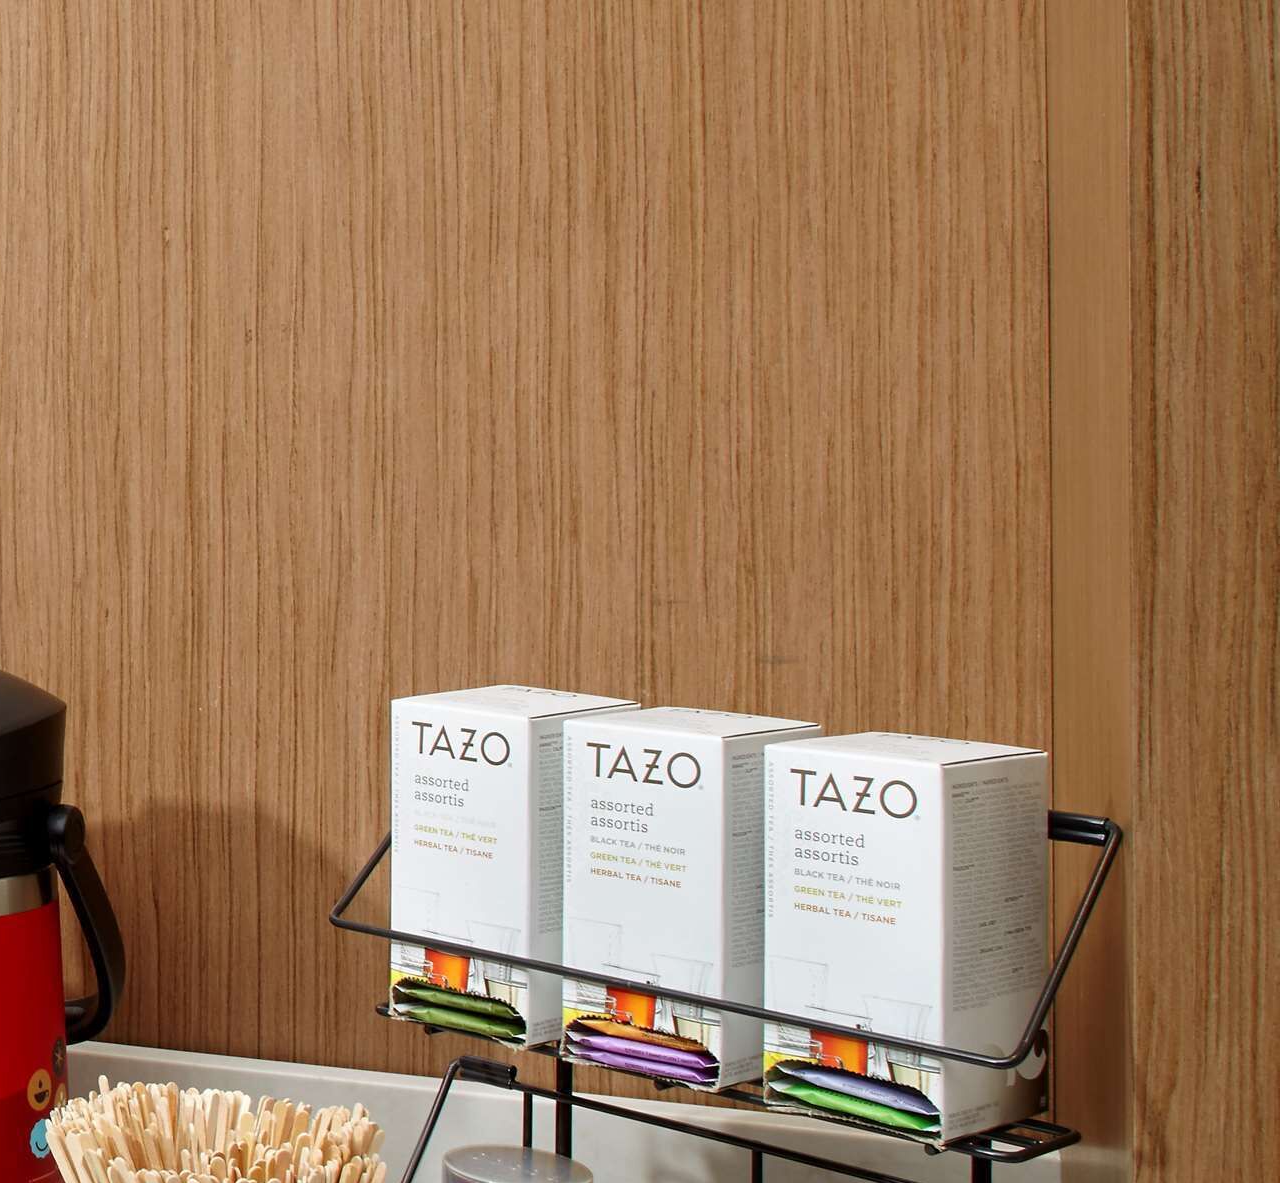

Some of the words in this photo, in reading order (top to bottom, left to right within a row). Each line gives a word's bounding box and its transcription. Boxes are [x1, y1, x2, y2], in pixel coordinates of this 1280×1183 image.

[411, 721, 510, 766] TAZO
[587, 742, 701, 788] TAZO
[414, 774, 469, 792] assorted
[790, 768, 917, 819] TAZO
[413, 790, 465, 808] assortis
[591, 798, 654, 817] assorted
[413, 824, 439, 834] GREEN
[440, 828, 454, 837] TEA
[479, 835, 497, 844] VERT
[591, 816, 648, 833] assortis
[590, 835, 617, 846] BLACK
[620, 839, 635, 848] TEA
[663, 846, 686, 856] NOIR
[795, 828, 865, 848] assorted
[414, 839, 442, 850] HERBAL
[443, 844, 458, 853] TEA
[465, 848, 493, 859] TISANE
[794, 847, 859, 866] assortis
[590, 851, 618, 862] GREEN
[621, 856, 636, 865] TEA
[664, 863, 687, 872] VERT
[591, 867, 624, 879] HERBAL
[626, 872, 642, 882] TEA
[651, 877, 681, 888] TISANE
[794, 868, 825, 879] BLACK
[827, 873, 845, 883] TEA
[876, 879, 901, 890] NOIR
[794, 886, 825, 896] GREEN
[827, 890, 845, 900] TEA
[877, 898, 903, 908] VERT
[794, 902, 830, 915] HERBAL
[833, 908, 851, 918] TEA
[862, 912, 896, 925] TISANE
